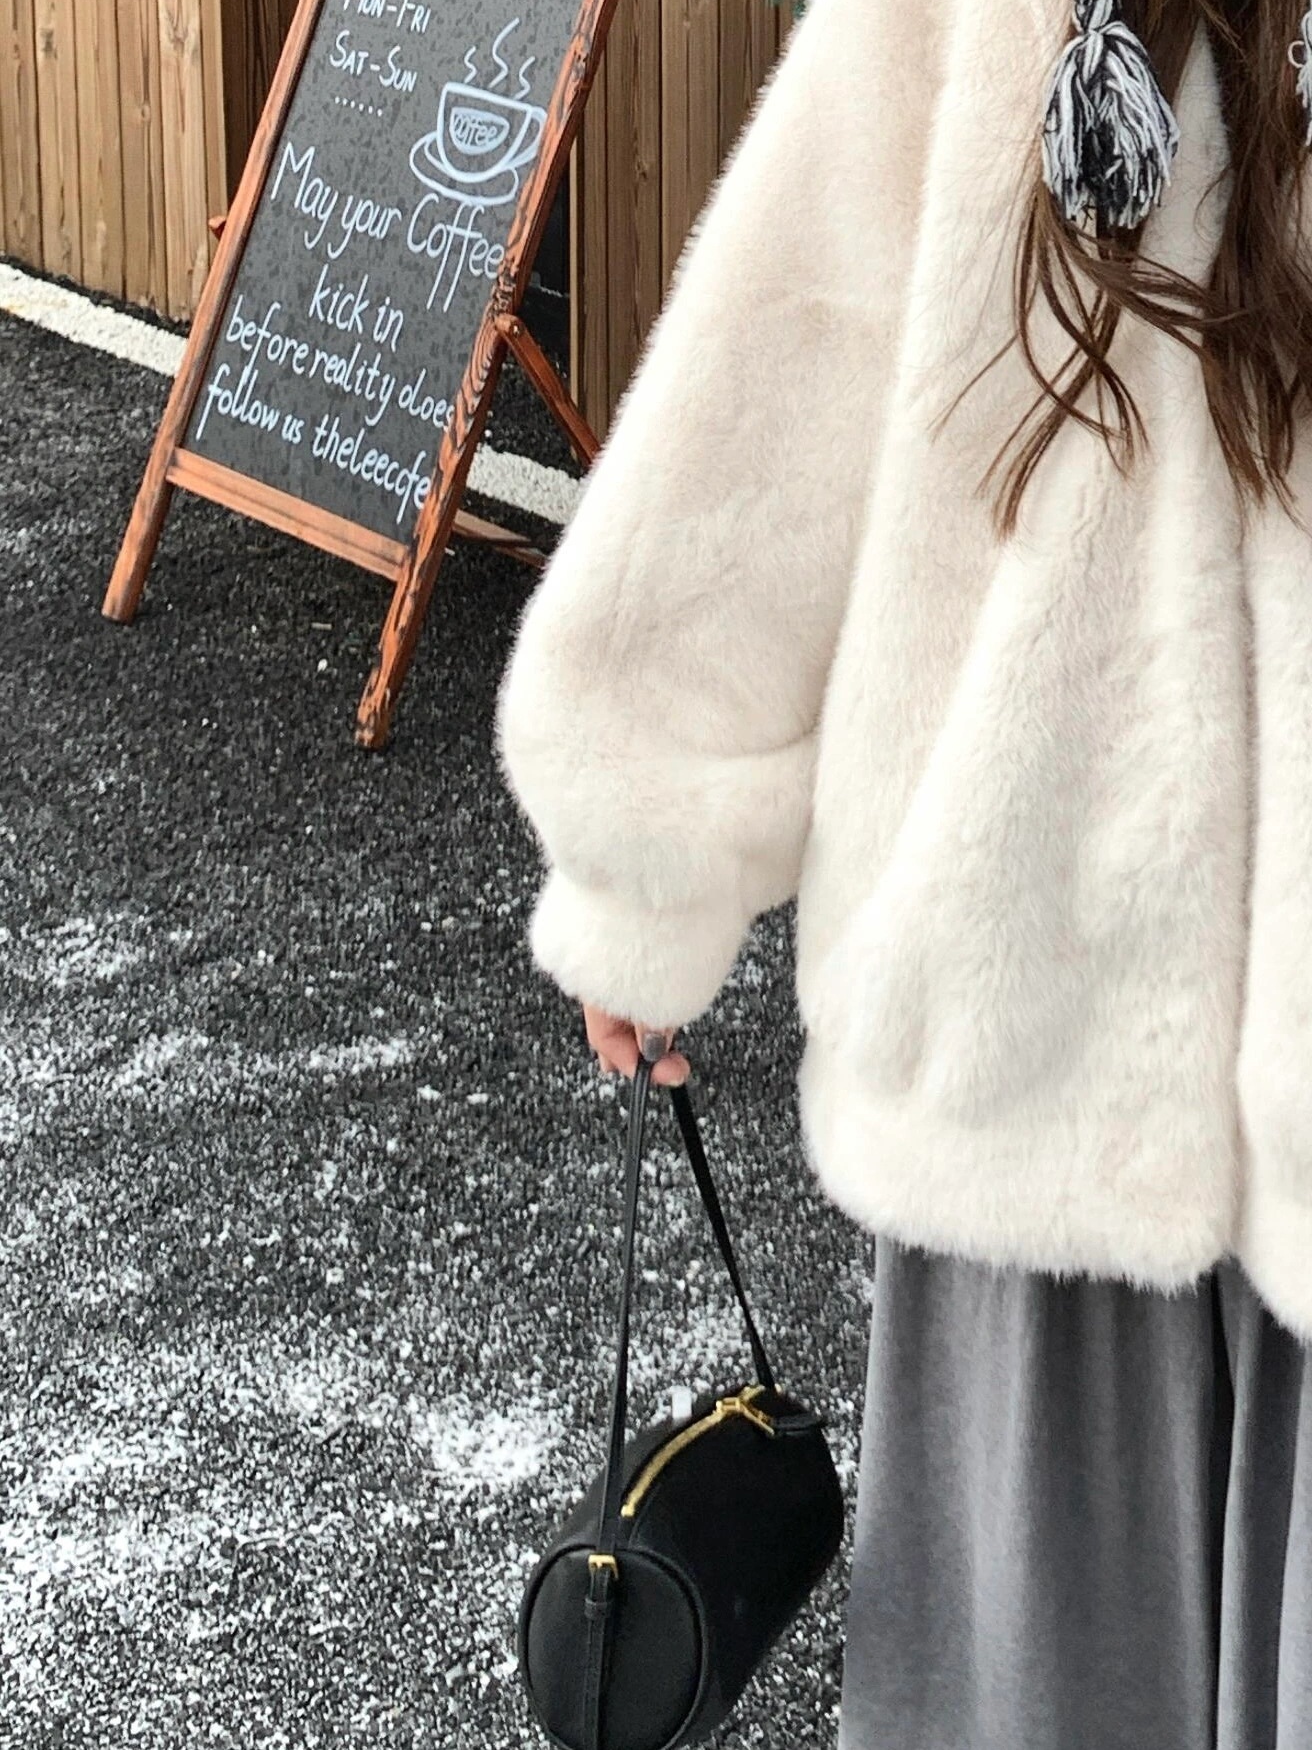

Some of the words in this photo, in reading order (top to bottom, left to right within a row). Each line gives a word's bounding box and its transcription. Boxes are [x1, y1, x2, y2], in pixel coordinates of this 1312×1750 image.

[270, 141, 339, 250] May
[327, 195, 402, 260] your
[407, 192, 505, 313] Coffee
[226, 294, 309, 374] before
[309, 342, 396, 426] reality
[308, 263, 370, 334] kick
[373, 296, 404, 353] in
[196, 362, 280, 440] follow
[282, 414, 305, 445] us
